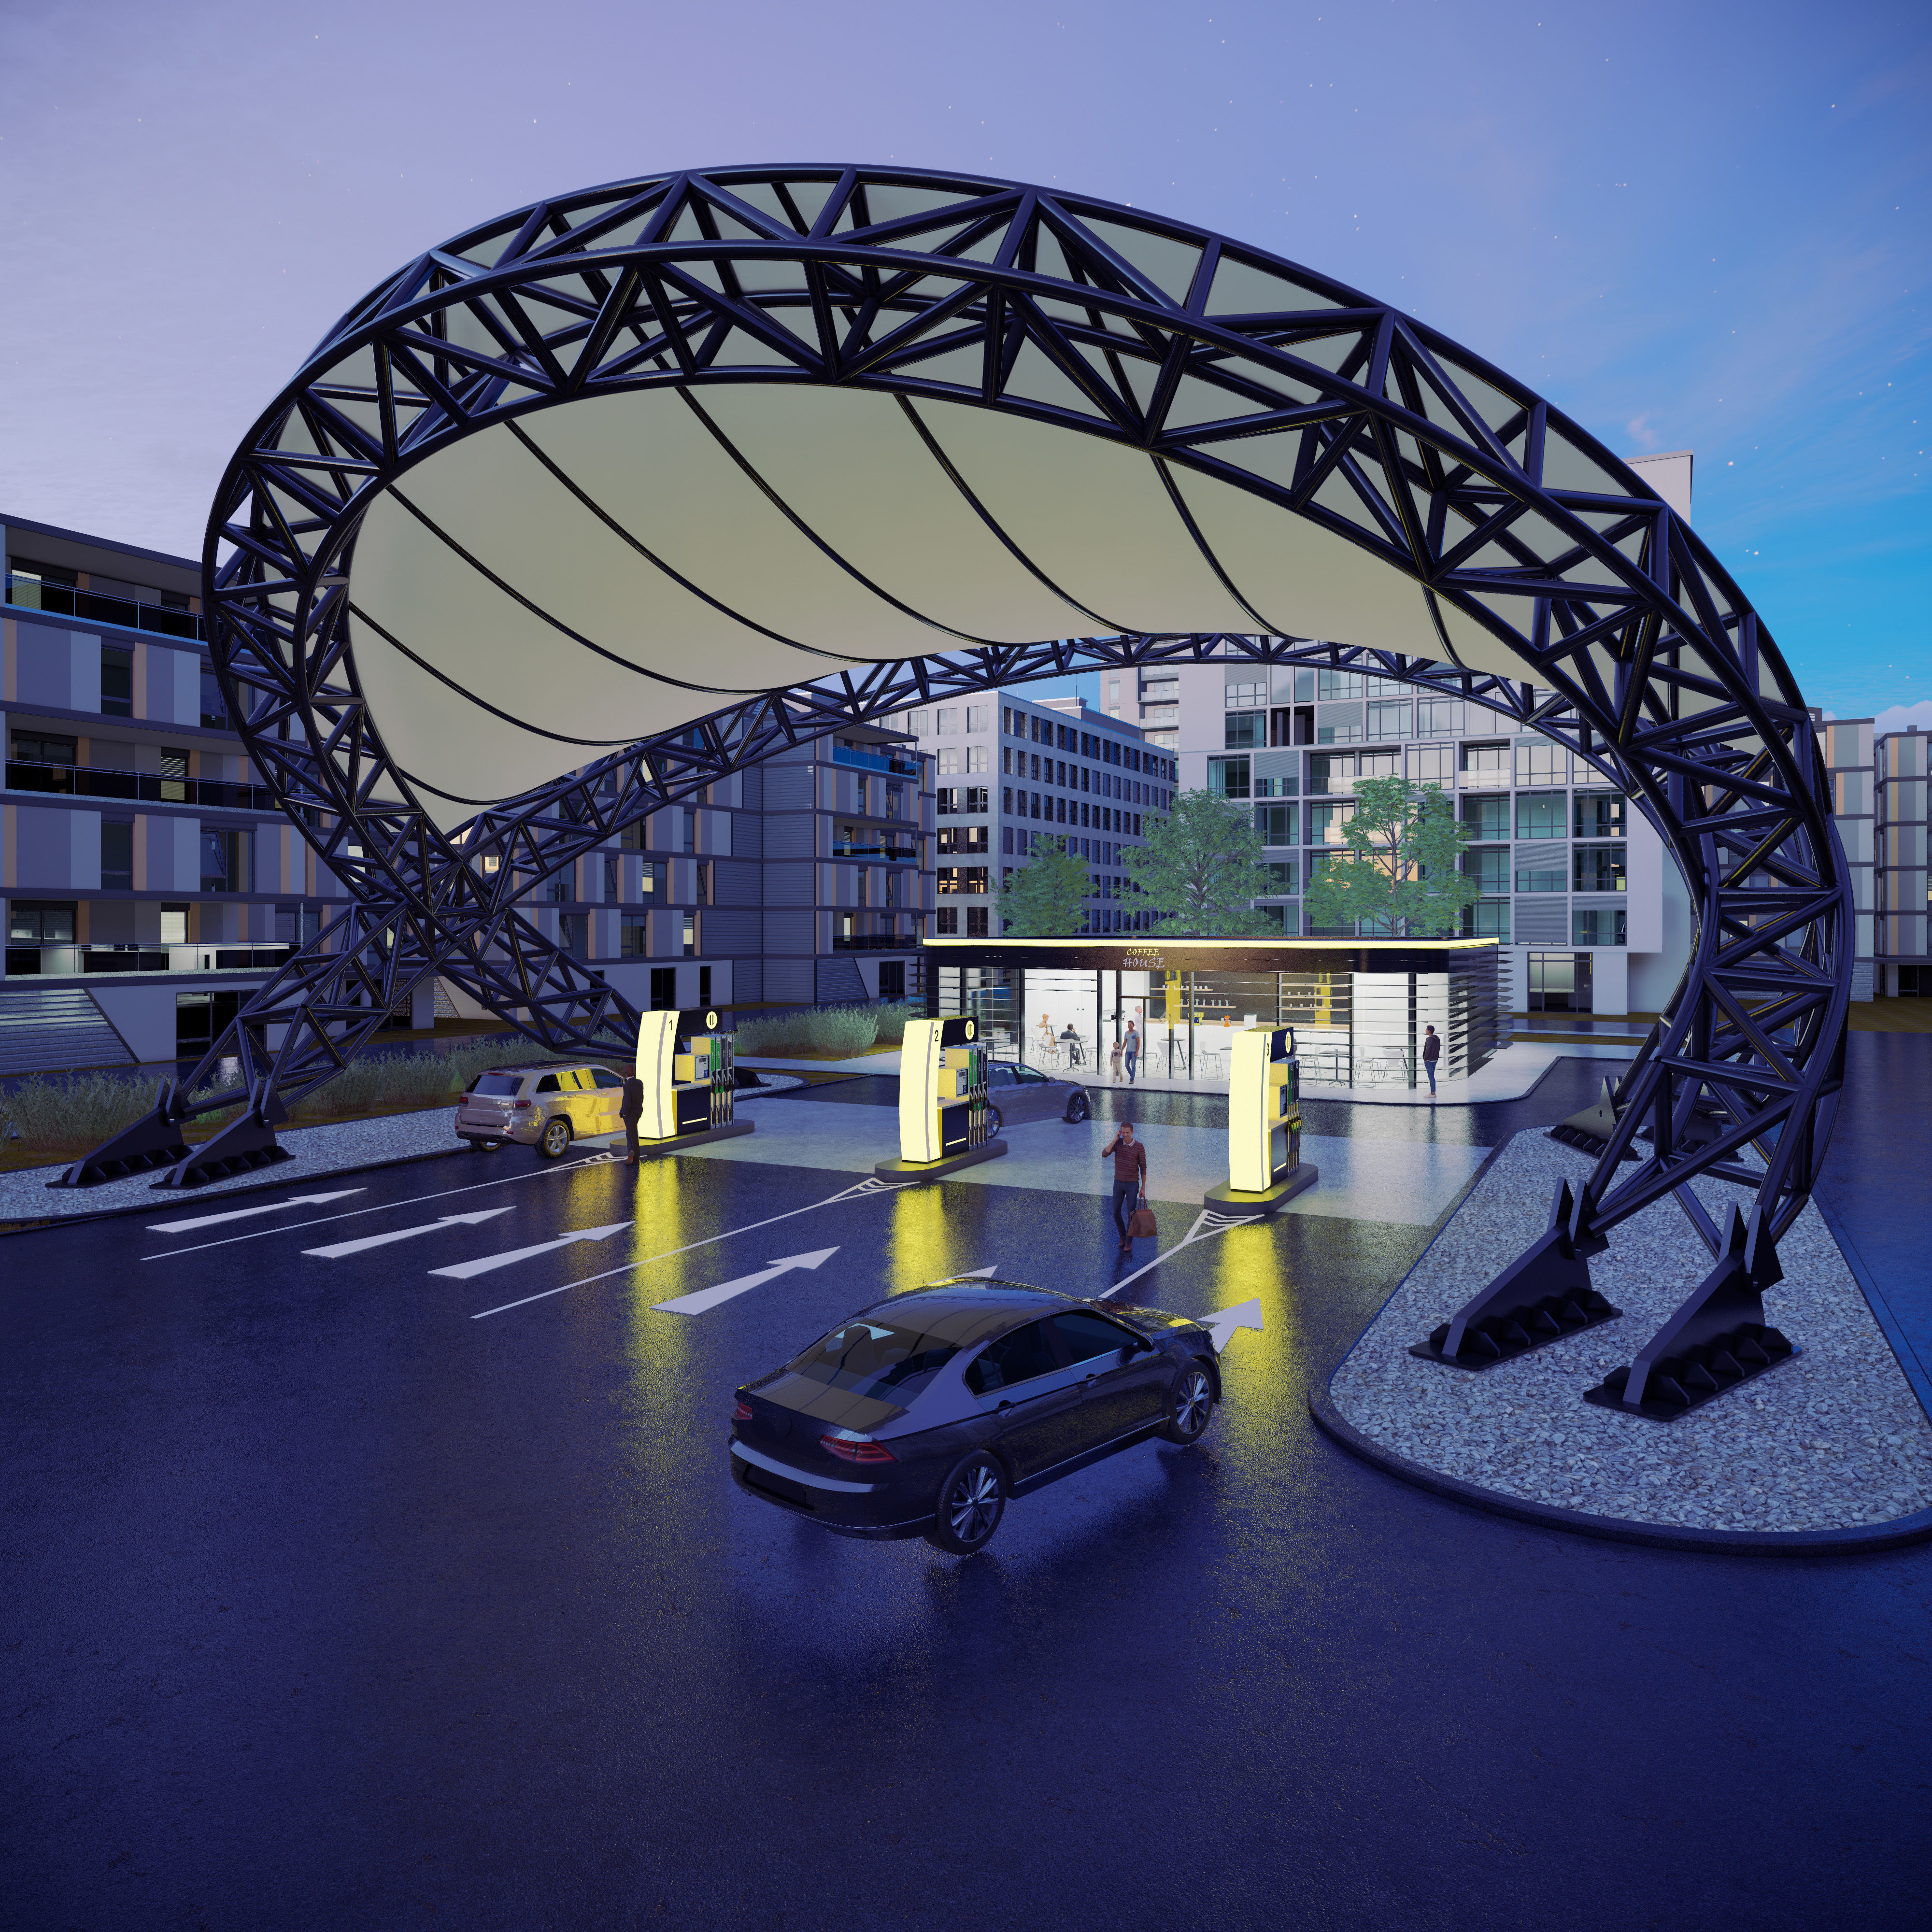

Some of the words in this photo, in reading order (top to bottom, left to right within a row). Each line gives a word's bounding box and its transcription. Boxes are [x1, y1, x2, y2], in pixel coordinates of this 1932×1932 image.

[1126, 948, 1160, 956] COFFEE
[1122, 957, 1165, 969] HOUSE
[669, 1020, 672, 1030] 1
[935, 1030, 938, 1041] 2
[1266, 1043, 1269, 1056] 3
